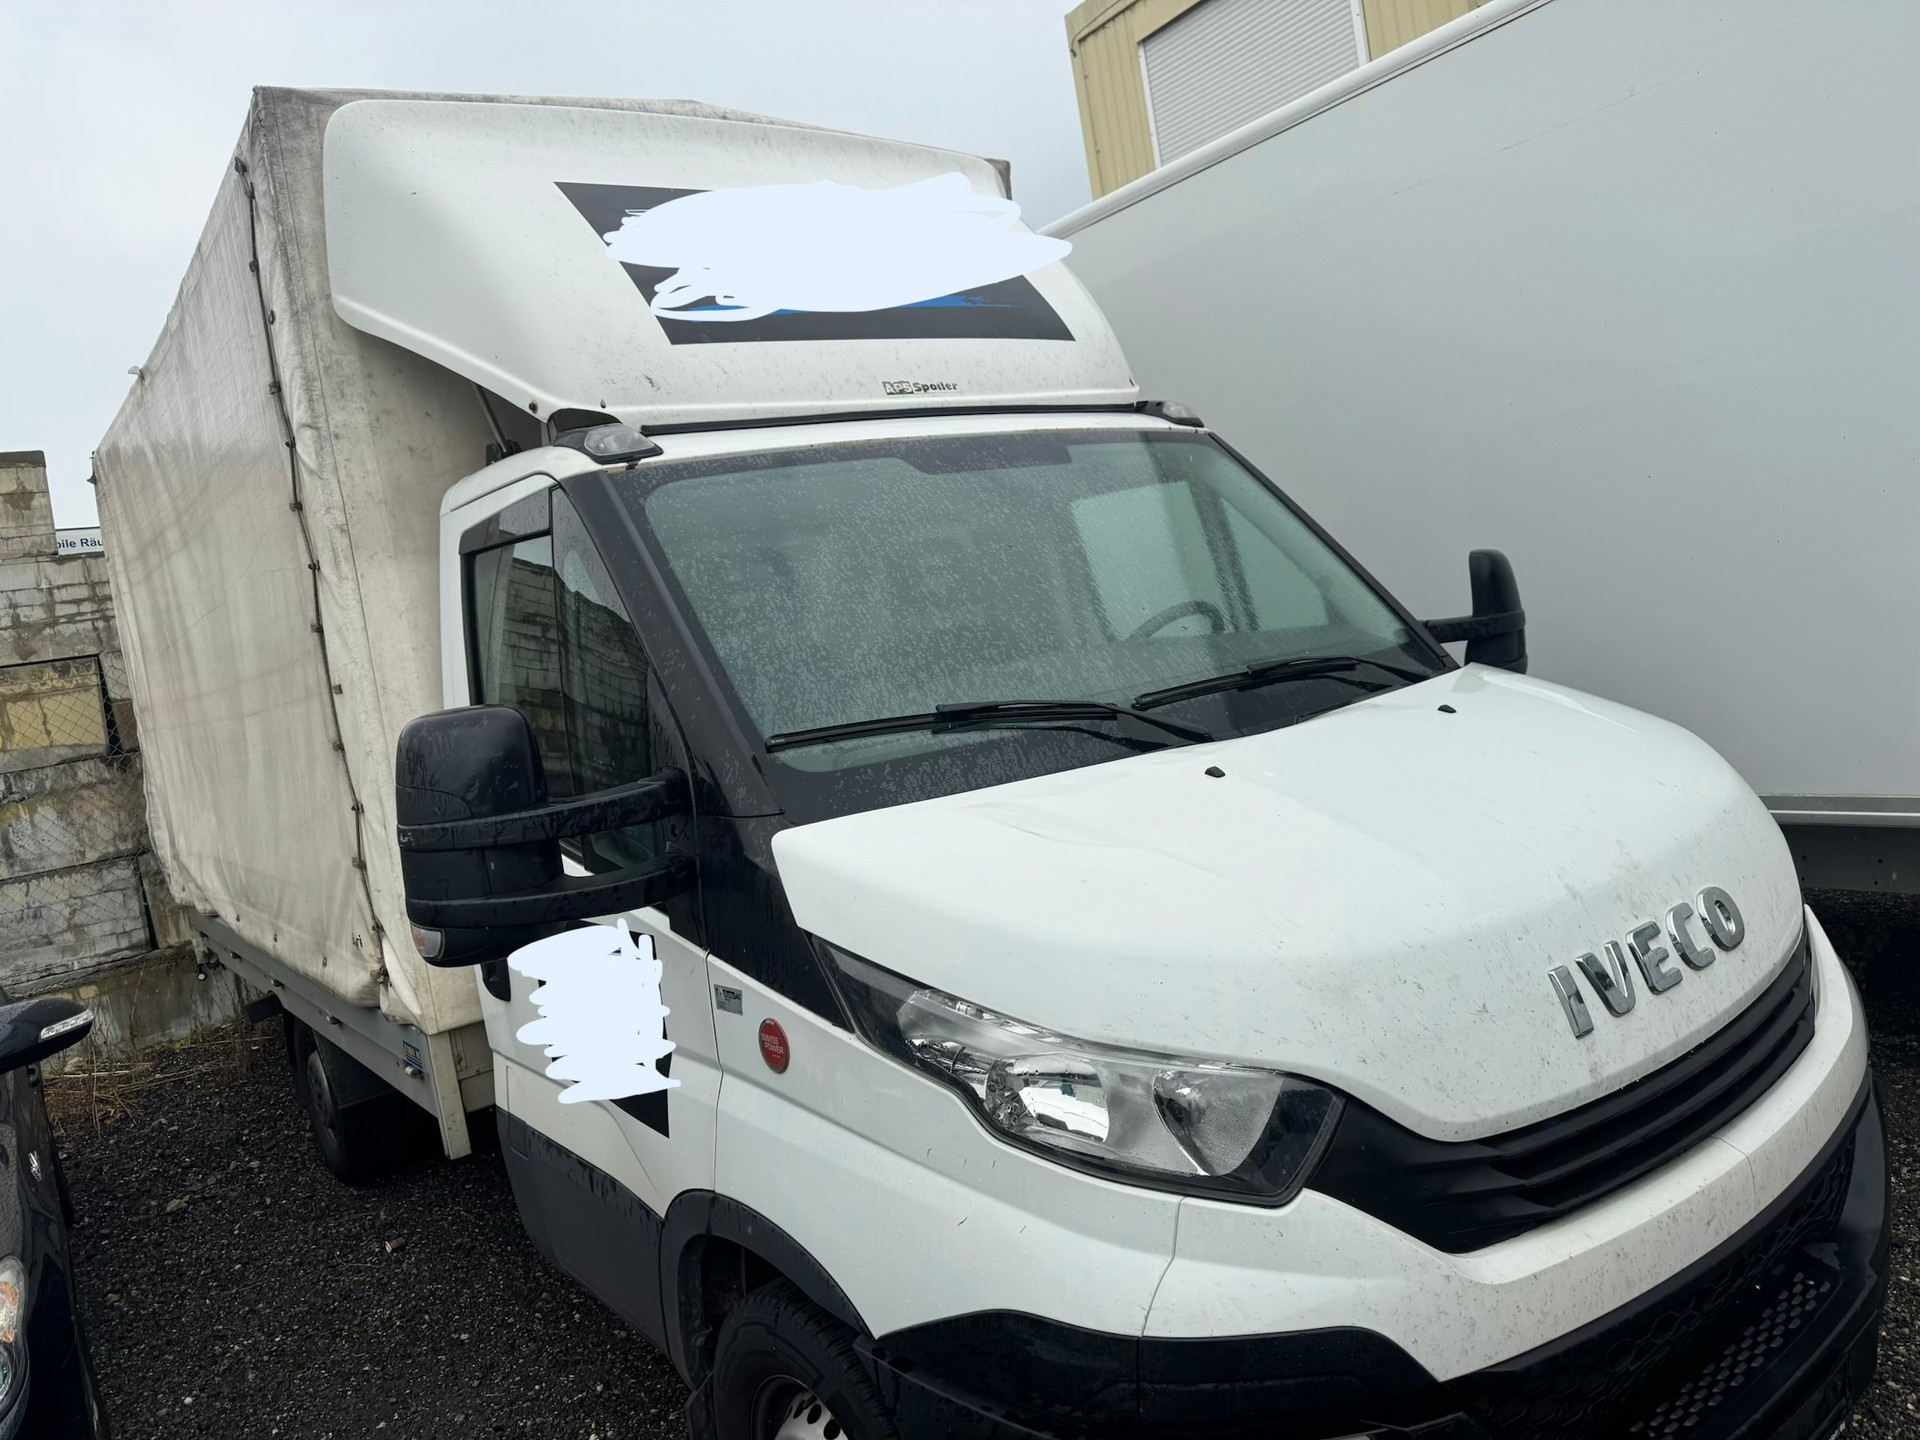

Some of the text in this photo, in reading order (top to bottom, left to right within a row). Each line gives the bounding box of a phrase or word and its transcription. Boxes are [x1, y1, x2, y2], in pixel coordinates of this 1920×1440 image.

[883, 381, 958, 395] APS Spoiler
[1548, 886, 1745, 1039] IVECO
[765, 1041, 784, 1055] POWER
